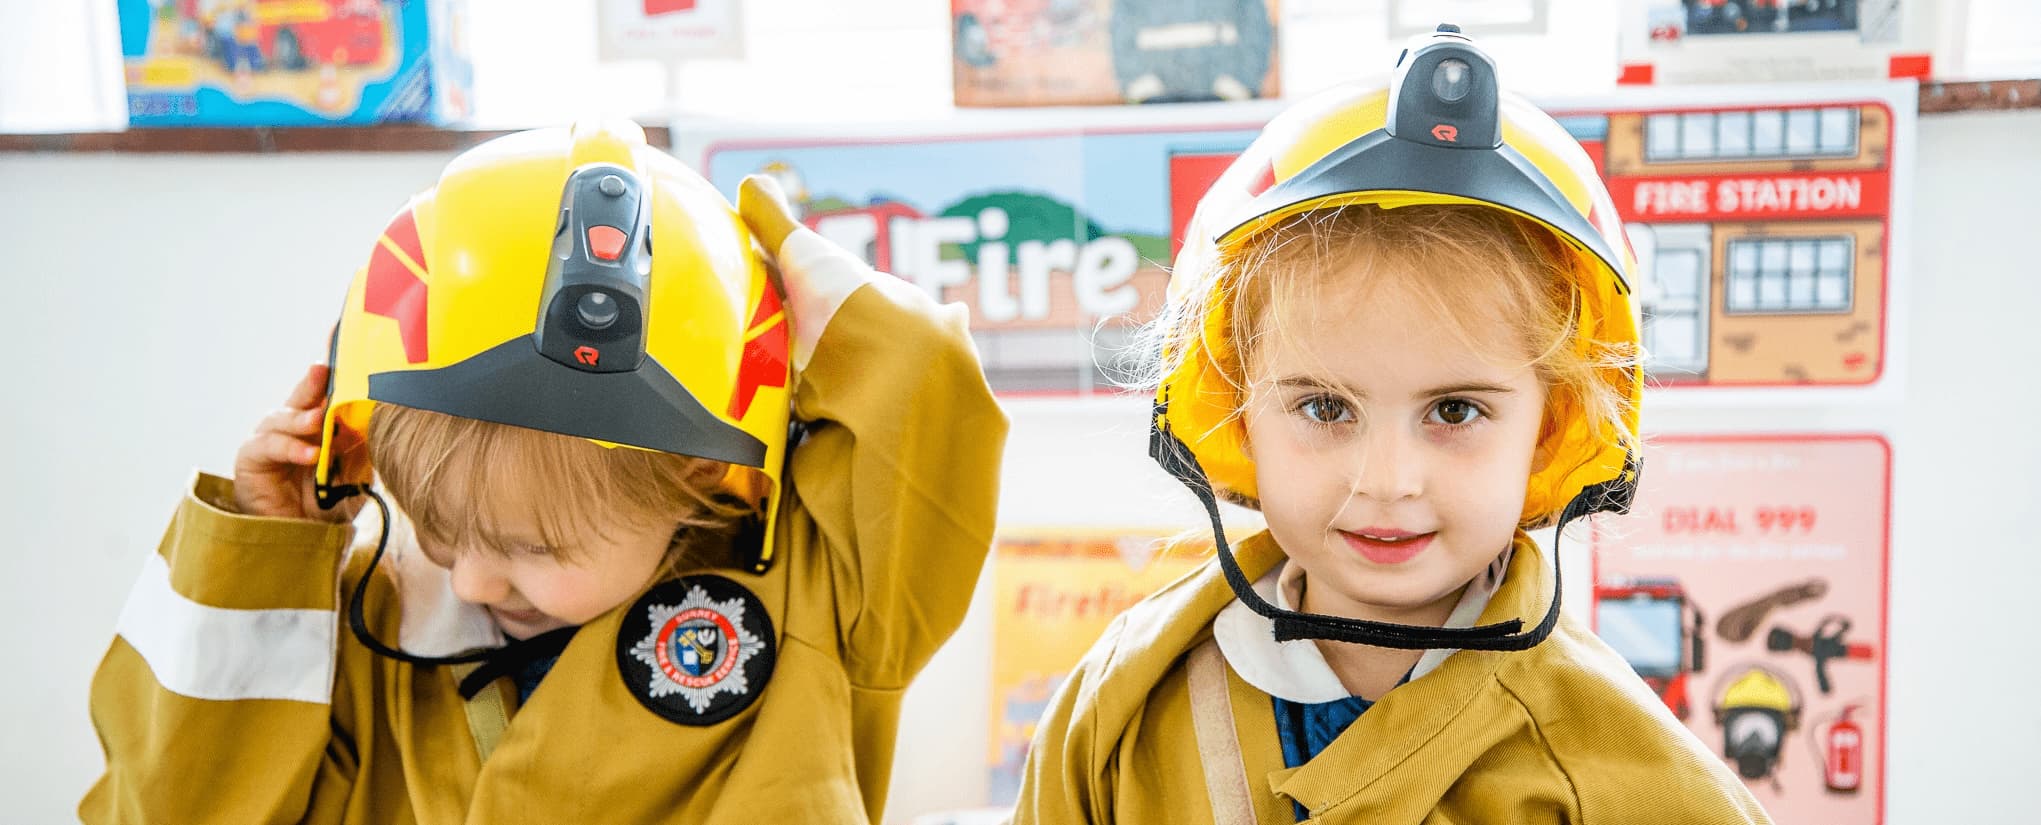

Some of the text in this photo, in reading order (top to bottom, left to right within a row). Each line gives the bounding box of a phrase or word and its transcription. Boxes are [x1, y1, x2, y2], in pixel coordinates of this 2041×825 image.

[1635, 178, 1861, 214] FIRE STATION
[918, 207, 1139, 321] Fire
[1756, 506, 1816, 534] 999
